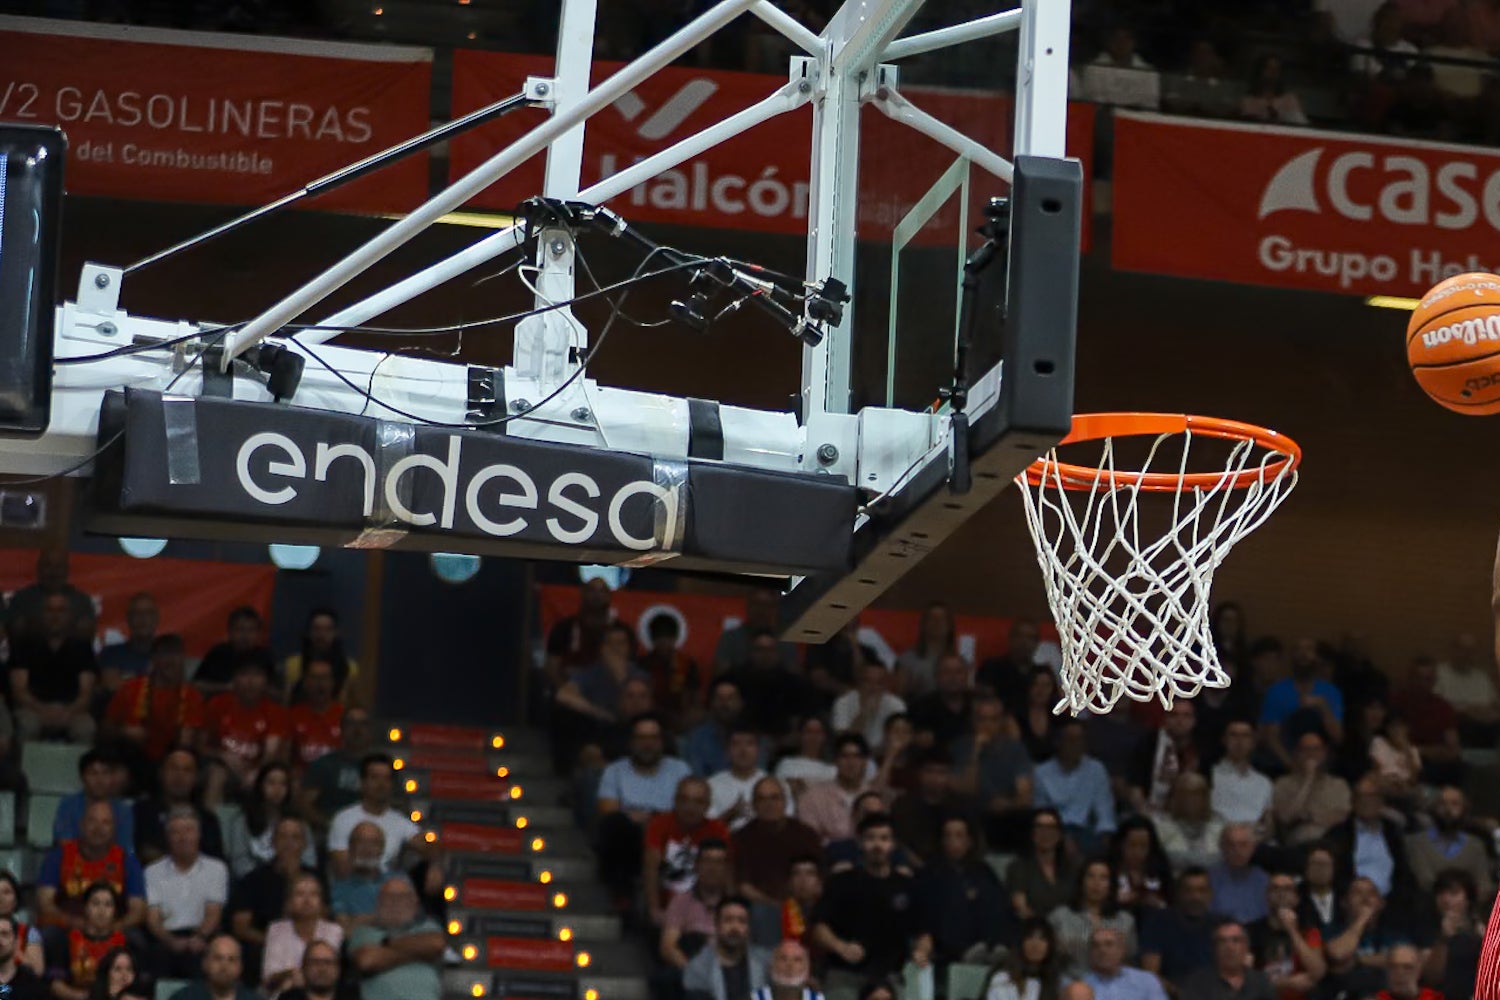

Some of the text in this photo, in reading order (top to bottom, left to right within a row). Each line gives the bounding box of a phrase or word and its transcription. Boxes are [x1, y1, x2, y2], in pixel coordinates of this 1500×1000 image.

[55, 87, 373, 144] GASOLINERAS
[122, 143, 274, 175] Combustible
[1258, 235, 1398, 288] Grupo
[235, 431, 682, 552] endesa
